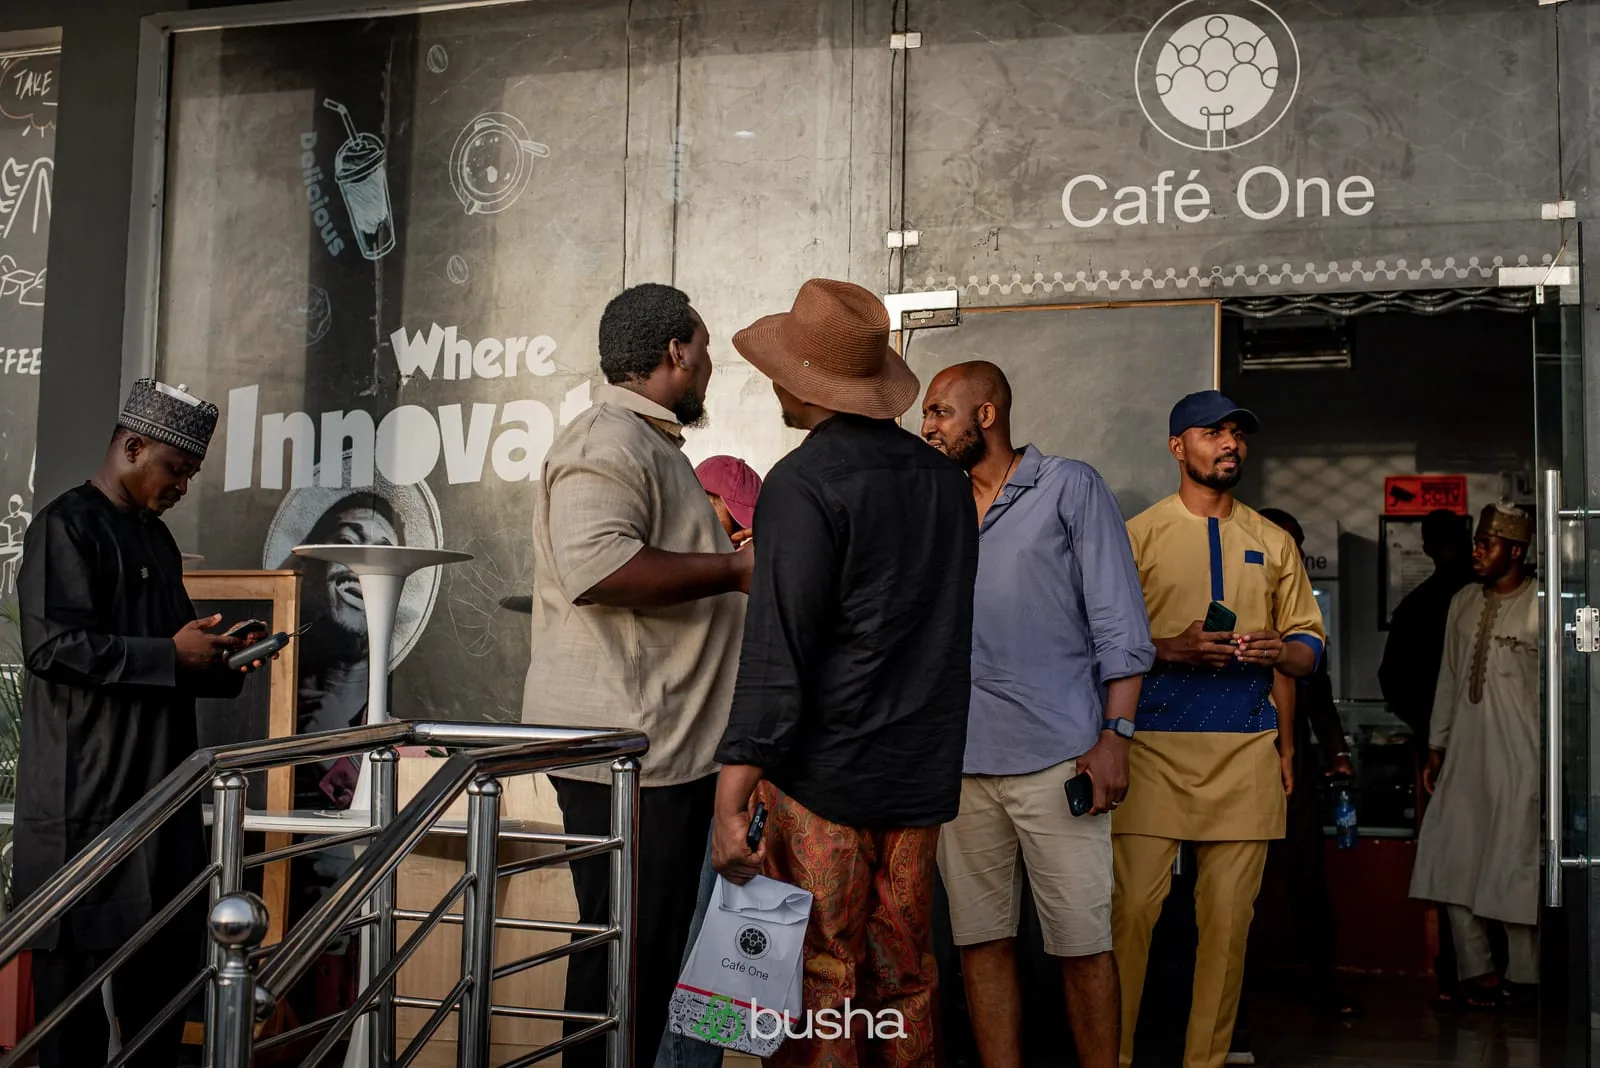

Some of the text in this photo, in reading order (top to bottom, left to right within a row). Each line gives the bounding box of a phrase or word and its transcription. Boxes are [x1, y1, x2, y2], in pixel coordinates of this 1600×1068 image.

[13, 68, 53, 100] TAKE
[300, 131, 345, 257] Delicious
[1061, 164, 1375, 229] Café One
[0, 346, 42, 376] FEE
[390, 322, 558, 381] Where
[1304, 555, 1328, 570] ne
[721, 957, 769, 981] Café One
